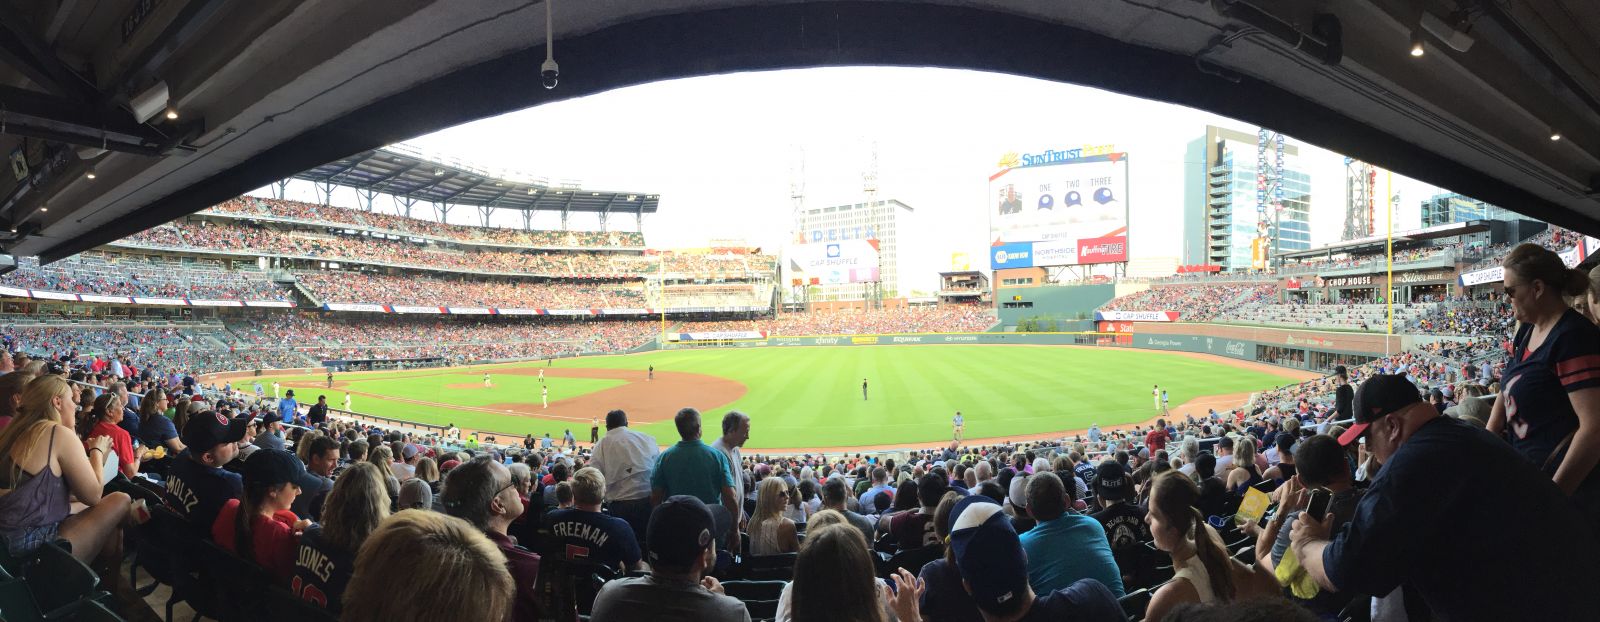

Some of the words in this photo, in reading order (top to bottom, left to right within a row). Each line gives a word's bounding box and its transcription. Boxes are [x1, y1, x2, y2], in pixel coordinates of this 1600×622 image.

[1066, 180, 1080, 189] TWO
[1091, 177, 1112, 187] THREE
[1039, 184, 1052, 193] ONE
[813, 225, 876, 242] DELTA
[1035, 247, 1076, 256] NORTHSIDE
[827, 257, 858, 266] SHUFFLE
[1328, 278, 1347, 287] CHOP
[1348, 276, 1371, 285] HOUSE
[1402, 271, 1428, 283] Silver
[1122, 311, 1134, 320] CAP
[1135, 311, 1159, 320] SHUFFLE
[1154, 339, 1170, 347] Georgia
[166, 475, 198, 513] SMOLTZ
[553, 521, 609, 548] FREEMAN
[296, 545, 335, 583] JONES
